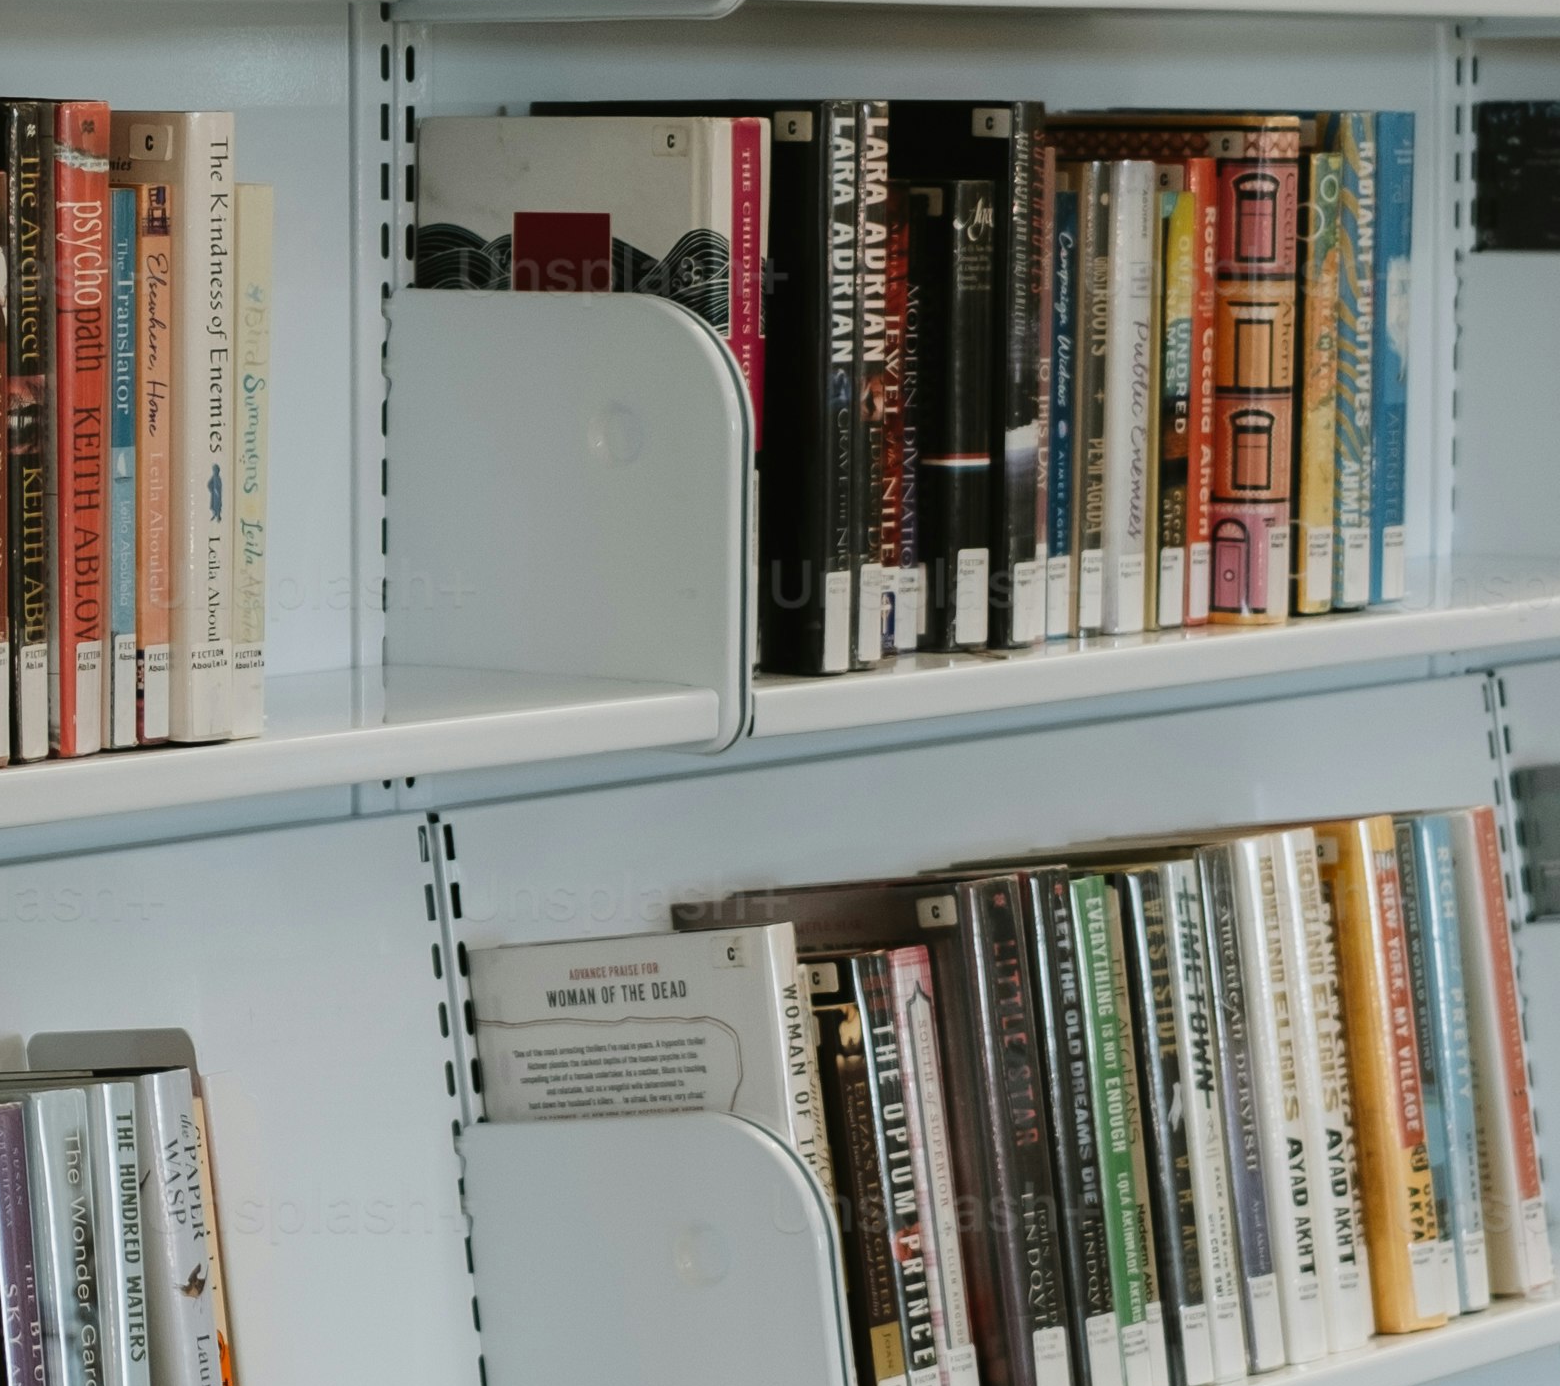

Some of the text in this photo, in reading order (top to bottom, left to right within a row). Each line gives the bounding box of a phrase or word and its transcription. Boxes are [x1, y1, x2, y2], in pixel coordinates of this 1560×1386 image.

[21, 156, 40, 205] The
[21, 216, 43, 362] Architect
[55, 199, 107, 374] psychopath
[828, 116, 856, 364] LARA ADRIAN
[115, 240, 135, 415] The Translator
[206, 136, 229, 454] The Kindness of Enemies
[73, 405, 102, 517] KEITH
[1126, 320, 1151, 541] Public Enemies
[22, 467, 43, 565] KEITH
[1380, 884, 1398, 931] NEW
[546, 979, 687, 1008] WOMAN OF THE DEAD
[1085, 897, 1128, 1153] EVERYTHING IS NOT ENOUGH
[1393, 1008, 1410, 1043] MY
[115, 1110, 134, 1152] THE
[1397, 1051, 1419, 1132] VILLAGE
[118, 1162, 142, 1267] HUNDRED
[873, 1020, 937, 1372] THE OPIUM PRINCE
[128, 1272, 147, 1364] WATERS
